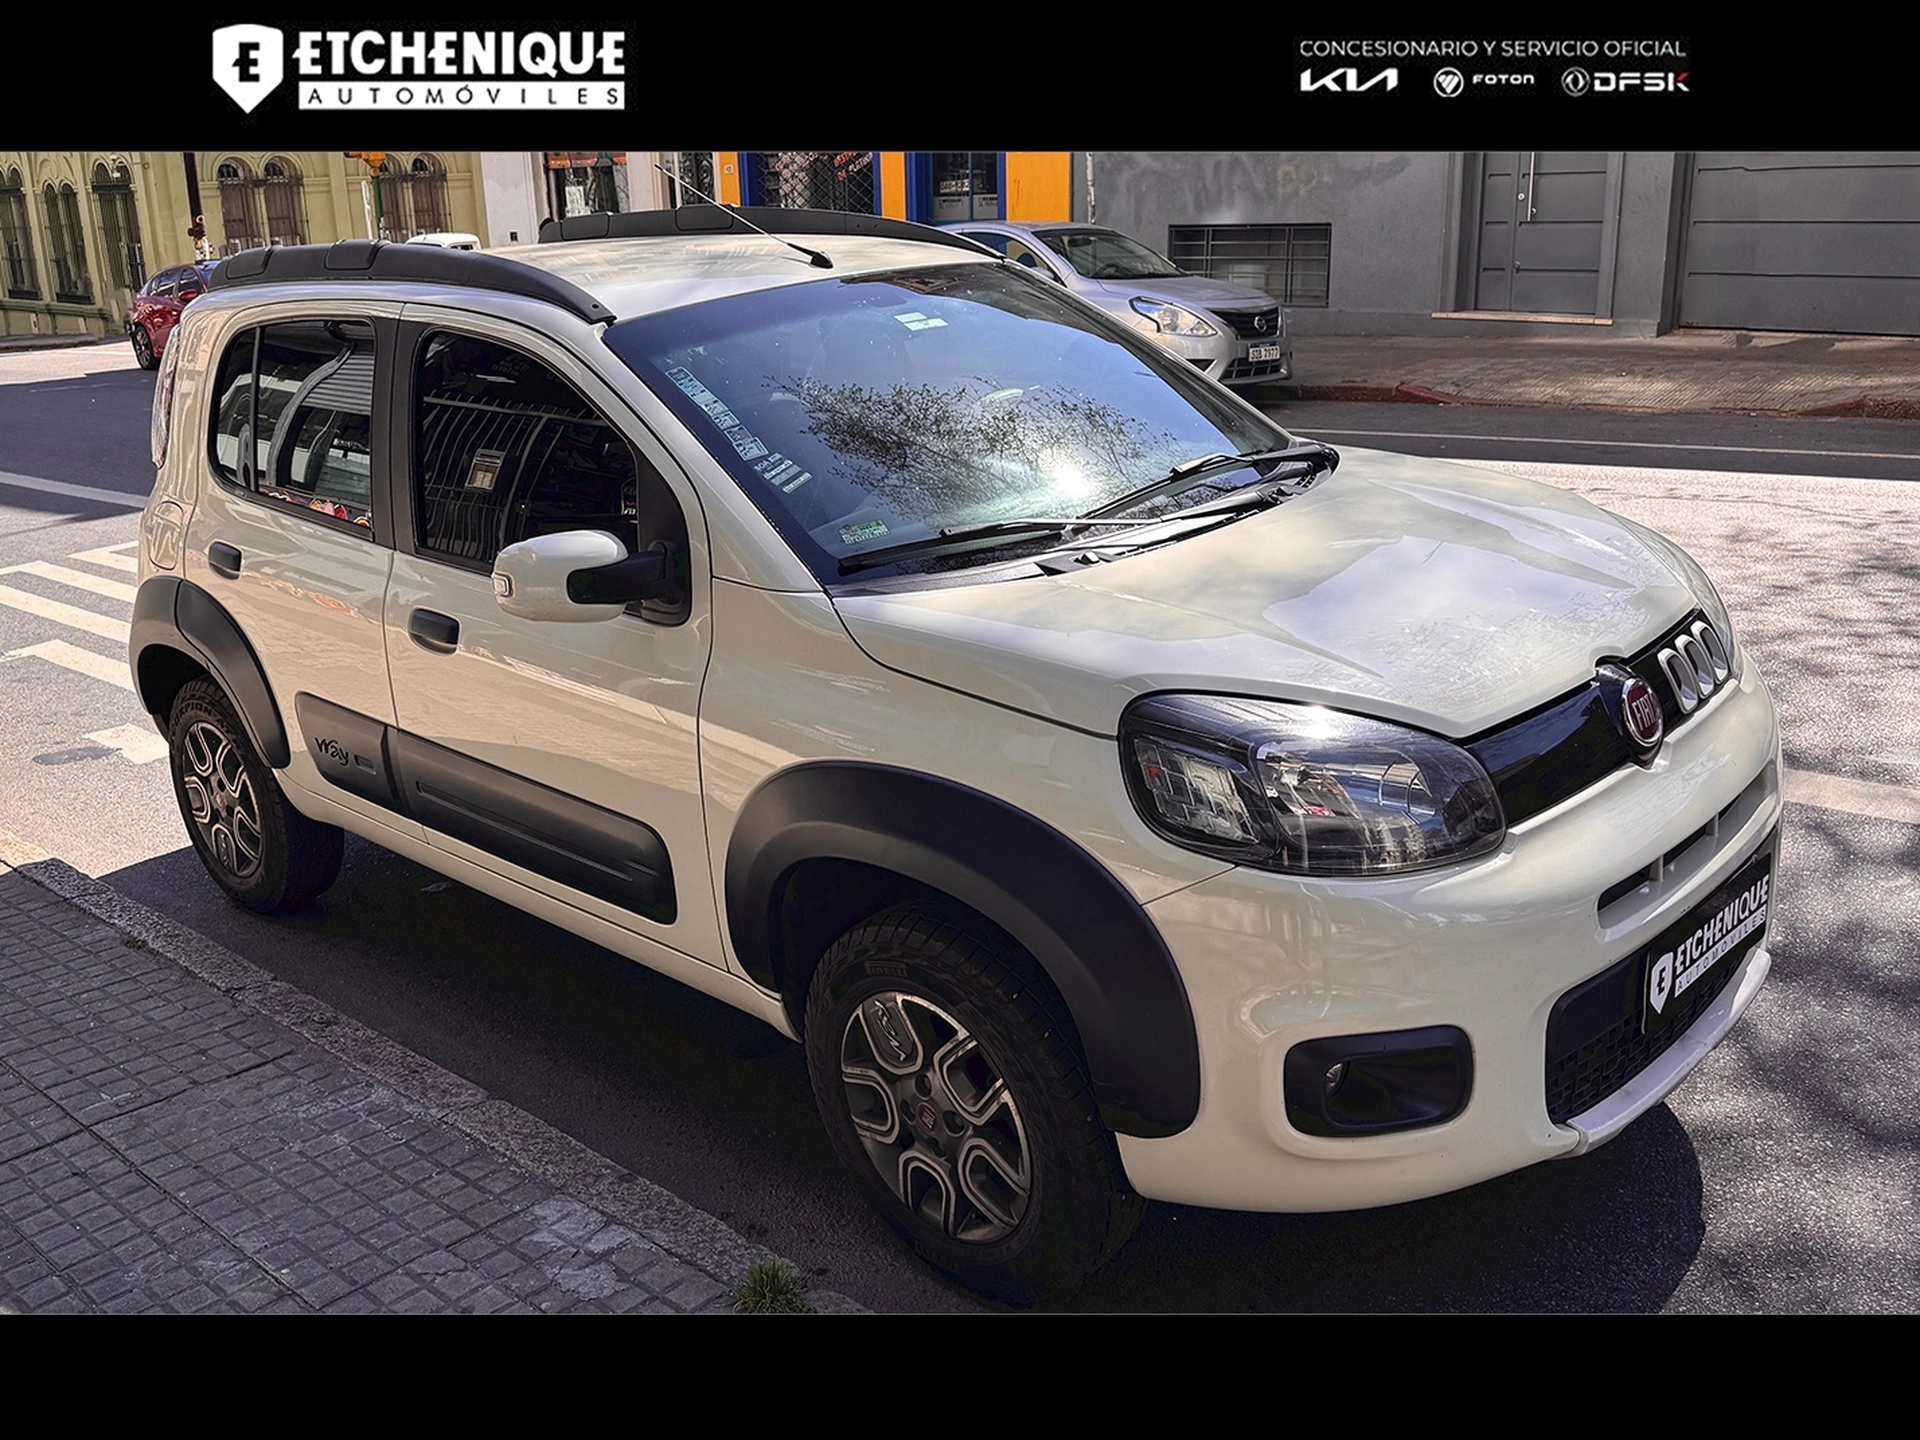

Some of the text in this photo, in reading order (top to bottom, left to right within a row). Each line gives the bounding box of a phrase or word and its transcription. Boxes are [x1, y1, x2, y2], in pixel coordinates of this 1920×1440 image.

[1631, 692, 1658, 731] FIAT
[314, 737, 350, 767] Way
[1674, 873, 1770, 976] ETCHENIQUE
